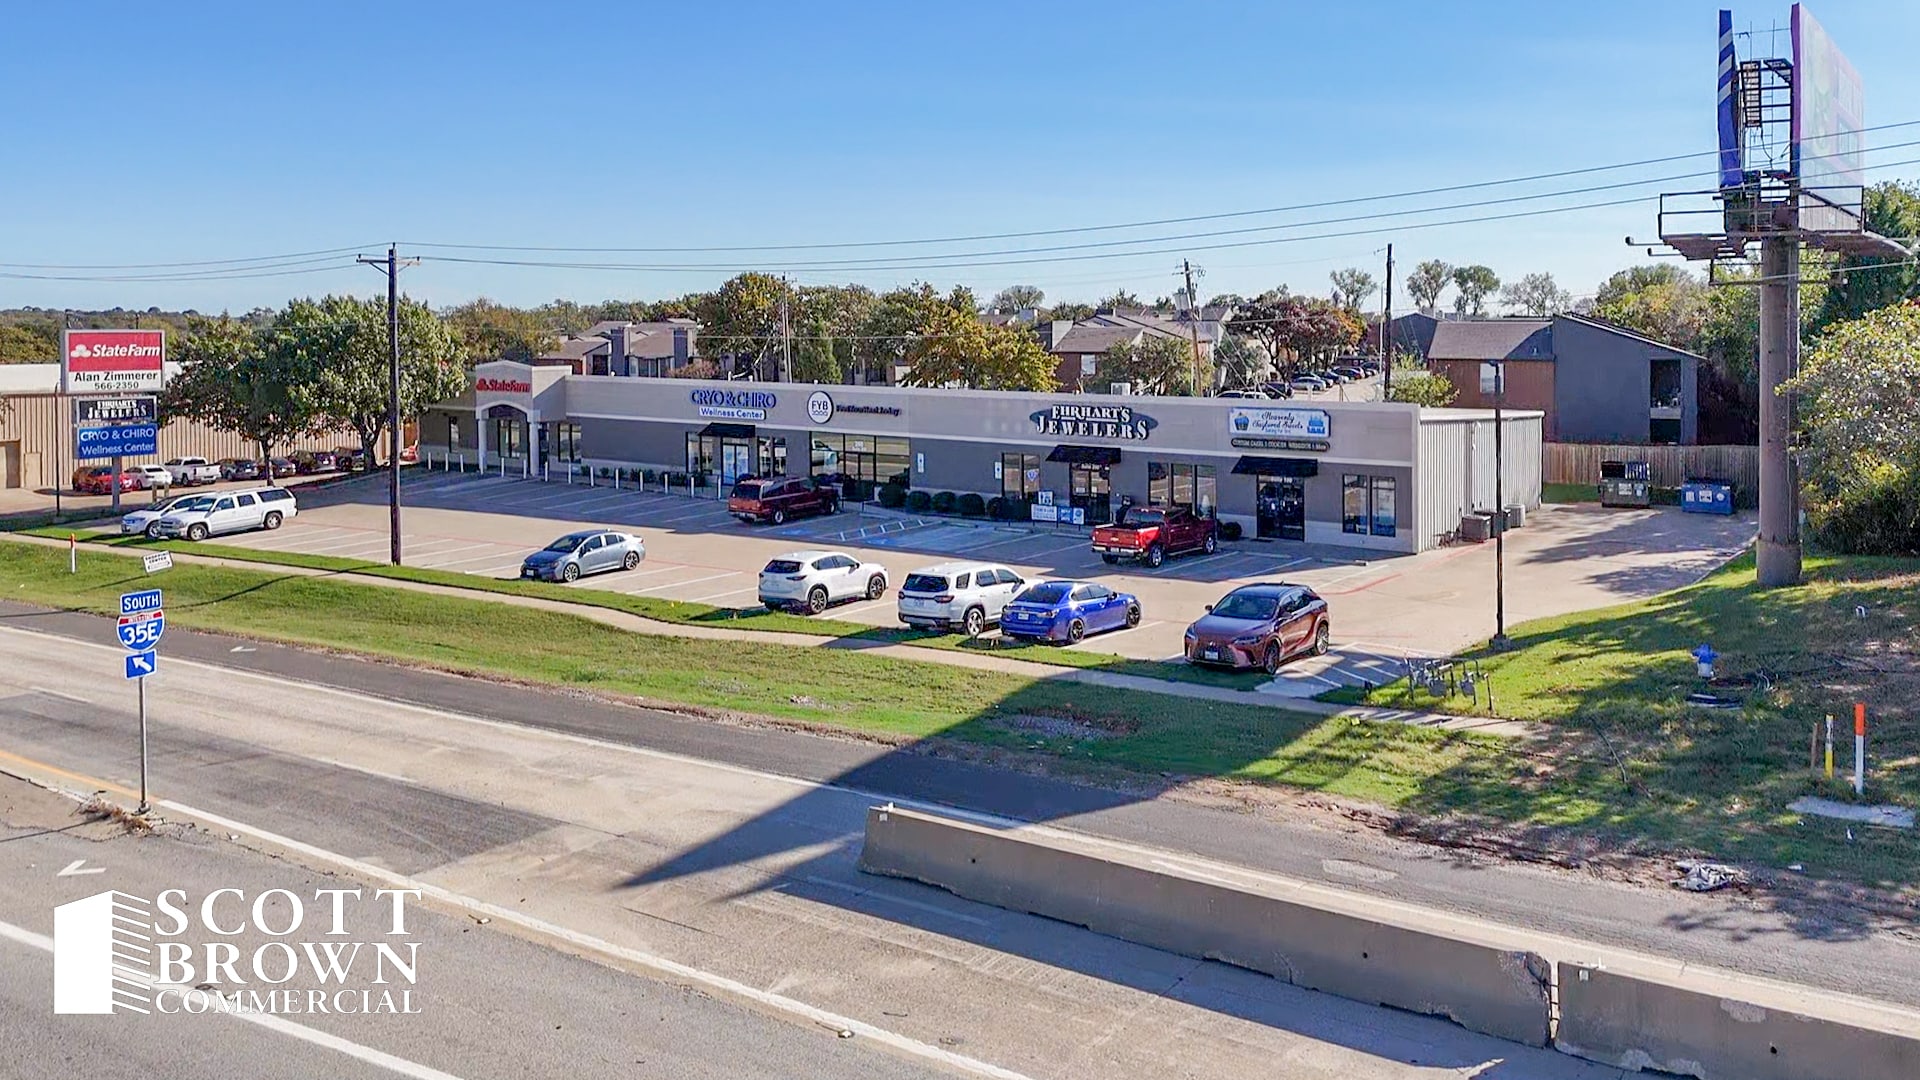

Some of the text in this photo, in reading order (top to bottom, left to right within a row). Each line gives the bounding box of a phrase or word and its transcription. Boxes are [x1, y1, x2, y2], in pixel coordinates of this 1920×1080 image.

[74, 371, 157, 382] Alan Zimmerer
[94, 382, 139, 390] 566-2350
[690, 390, 776, 408] CRYO & CHIRO
[811, 401, 828, 410] FYB
[88, 406, 147, 418] JEWELERS
[701, 408, 763, 418] Wellness Center
[1052, 404, 1131, 422] EHRHART'S
[1036, 415, 1148, 439] JEWELERS
[80, 428, 154, 441] CRYO & CHIRO
[82, 443, 154, 455] Wellness Center
[124, 595, 159, 611] SOUTH
[123, 622, 158, 645] 35E
